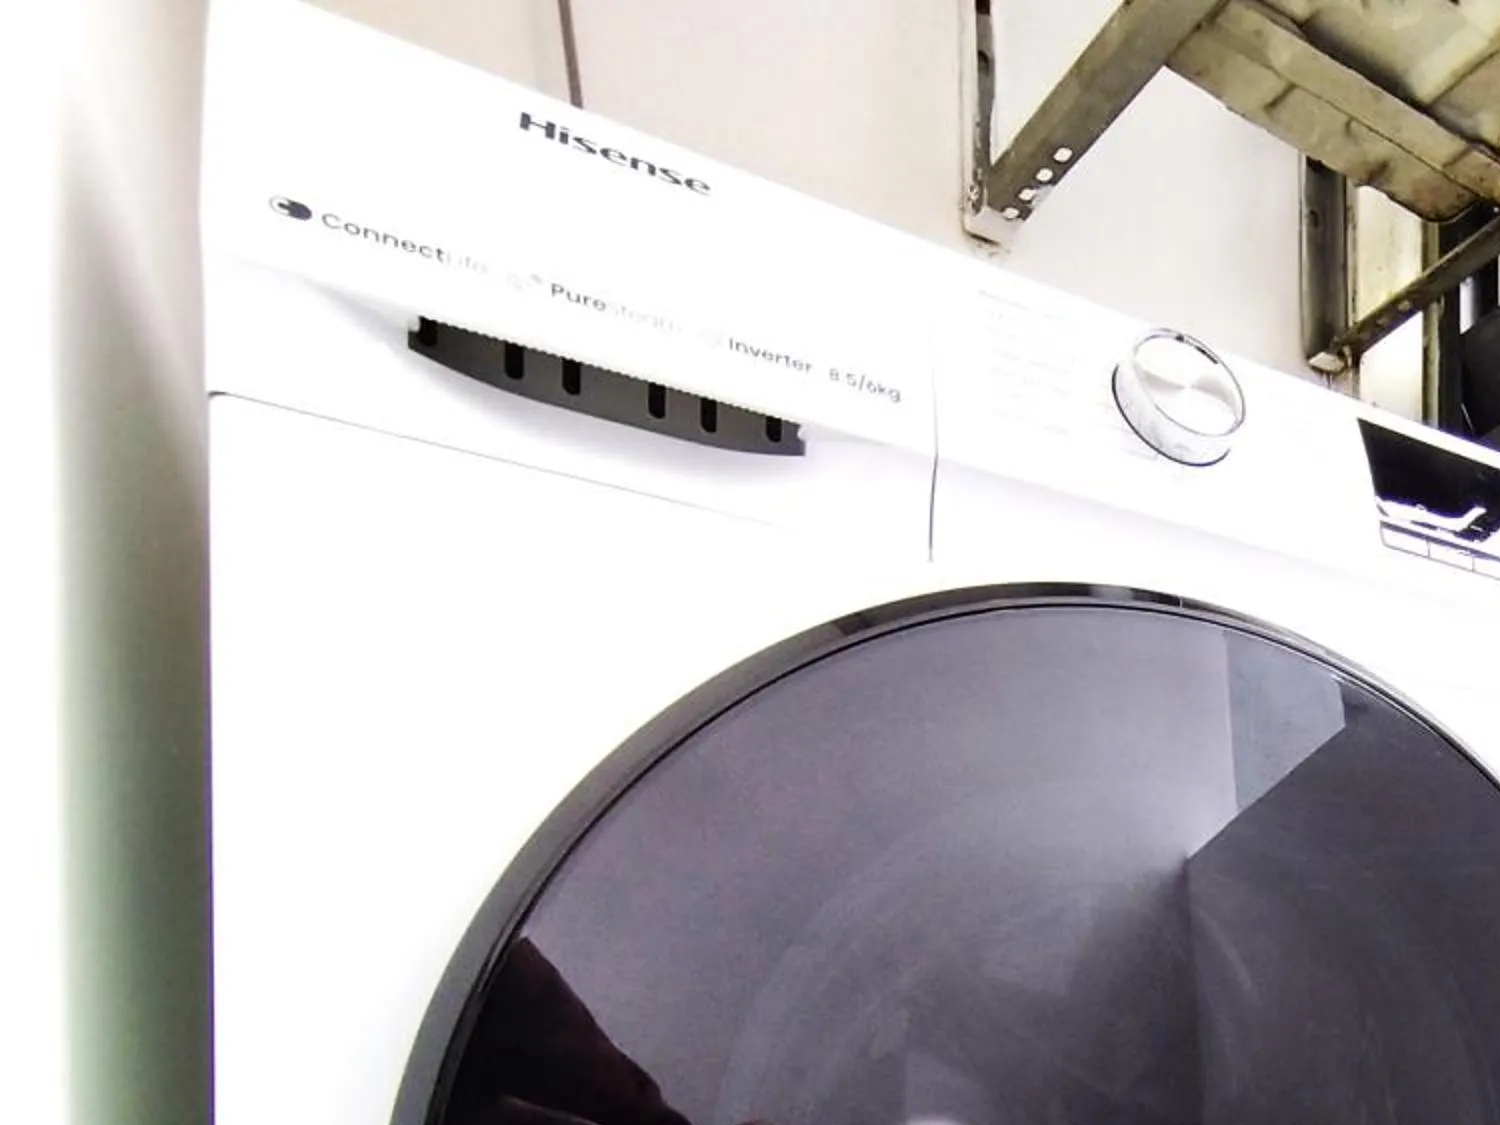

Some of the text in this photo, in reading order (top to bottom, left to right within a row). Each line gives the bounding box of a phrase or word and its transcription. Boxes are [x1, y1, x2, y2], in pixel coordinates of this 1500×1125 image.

[518, 111, 712, 196] Hisense
[728, 336, 902, 404] Inverter 85/6kg
